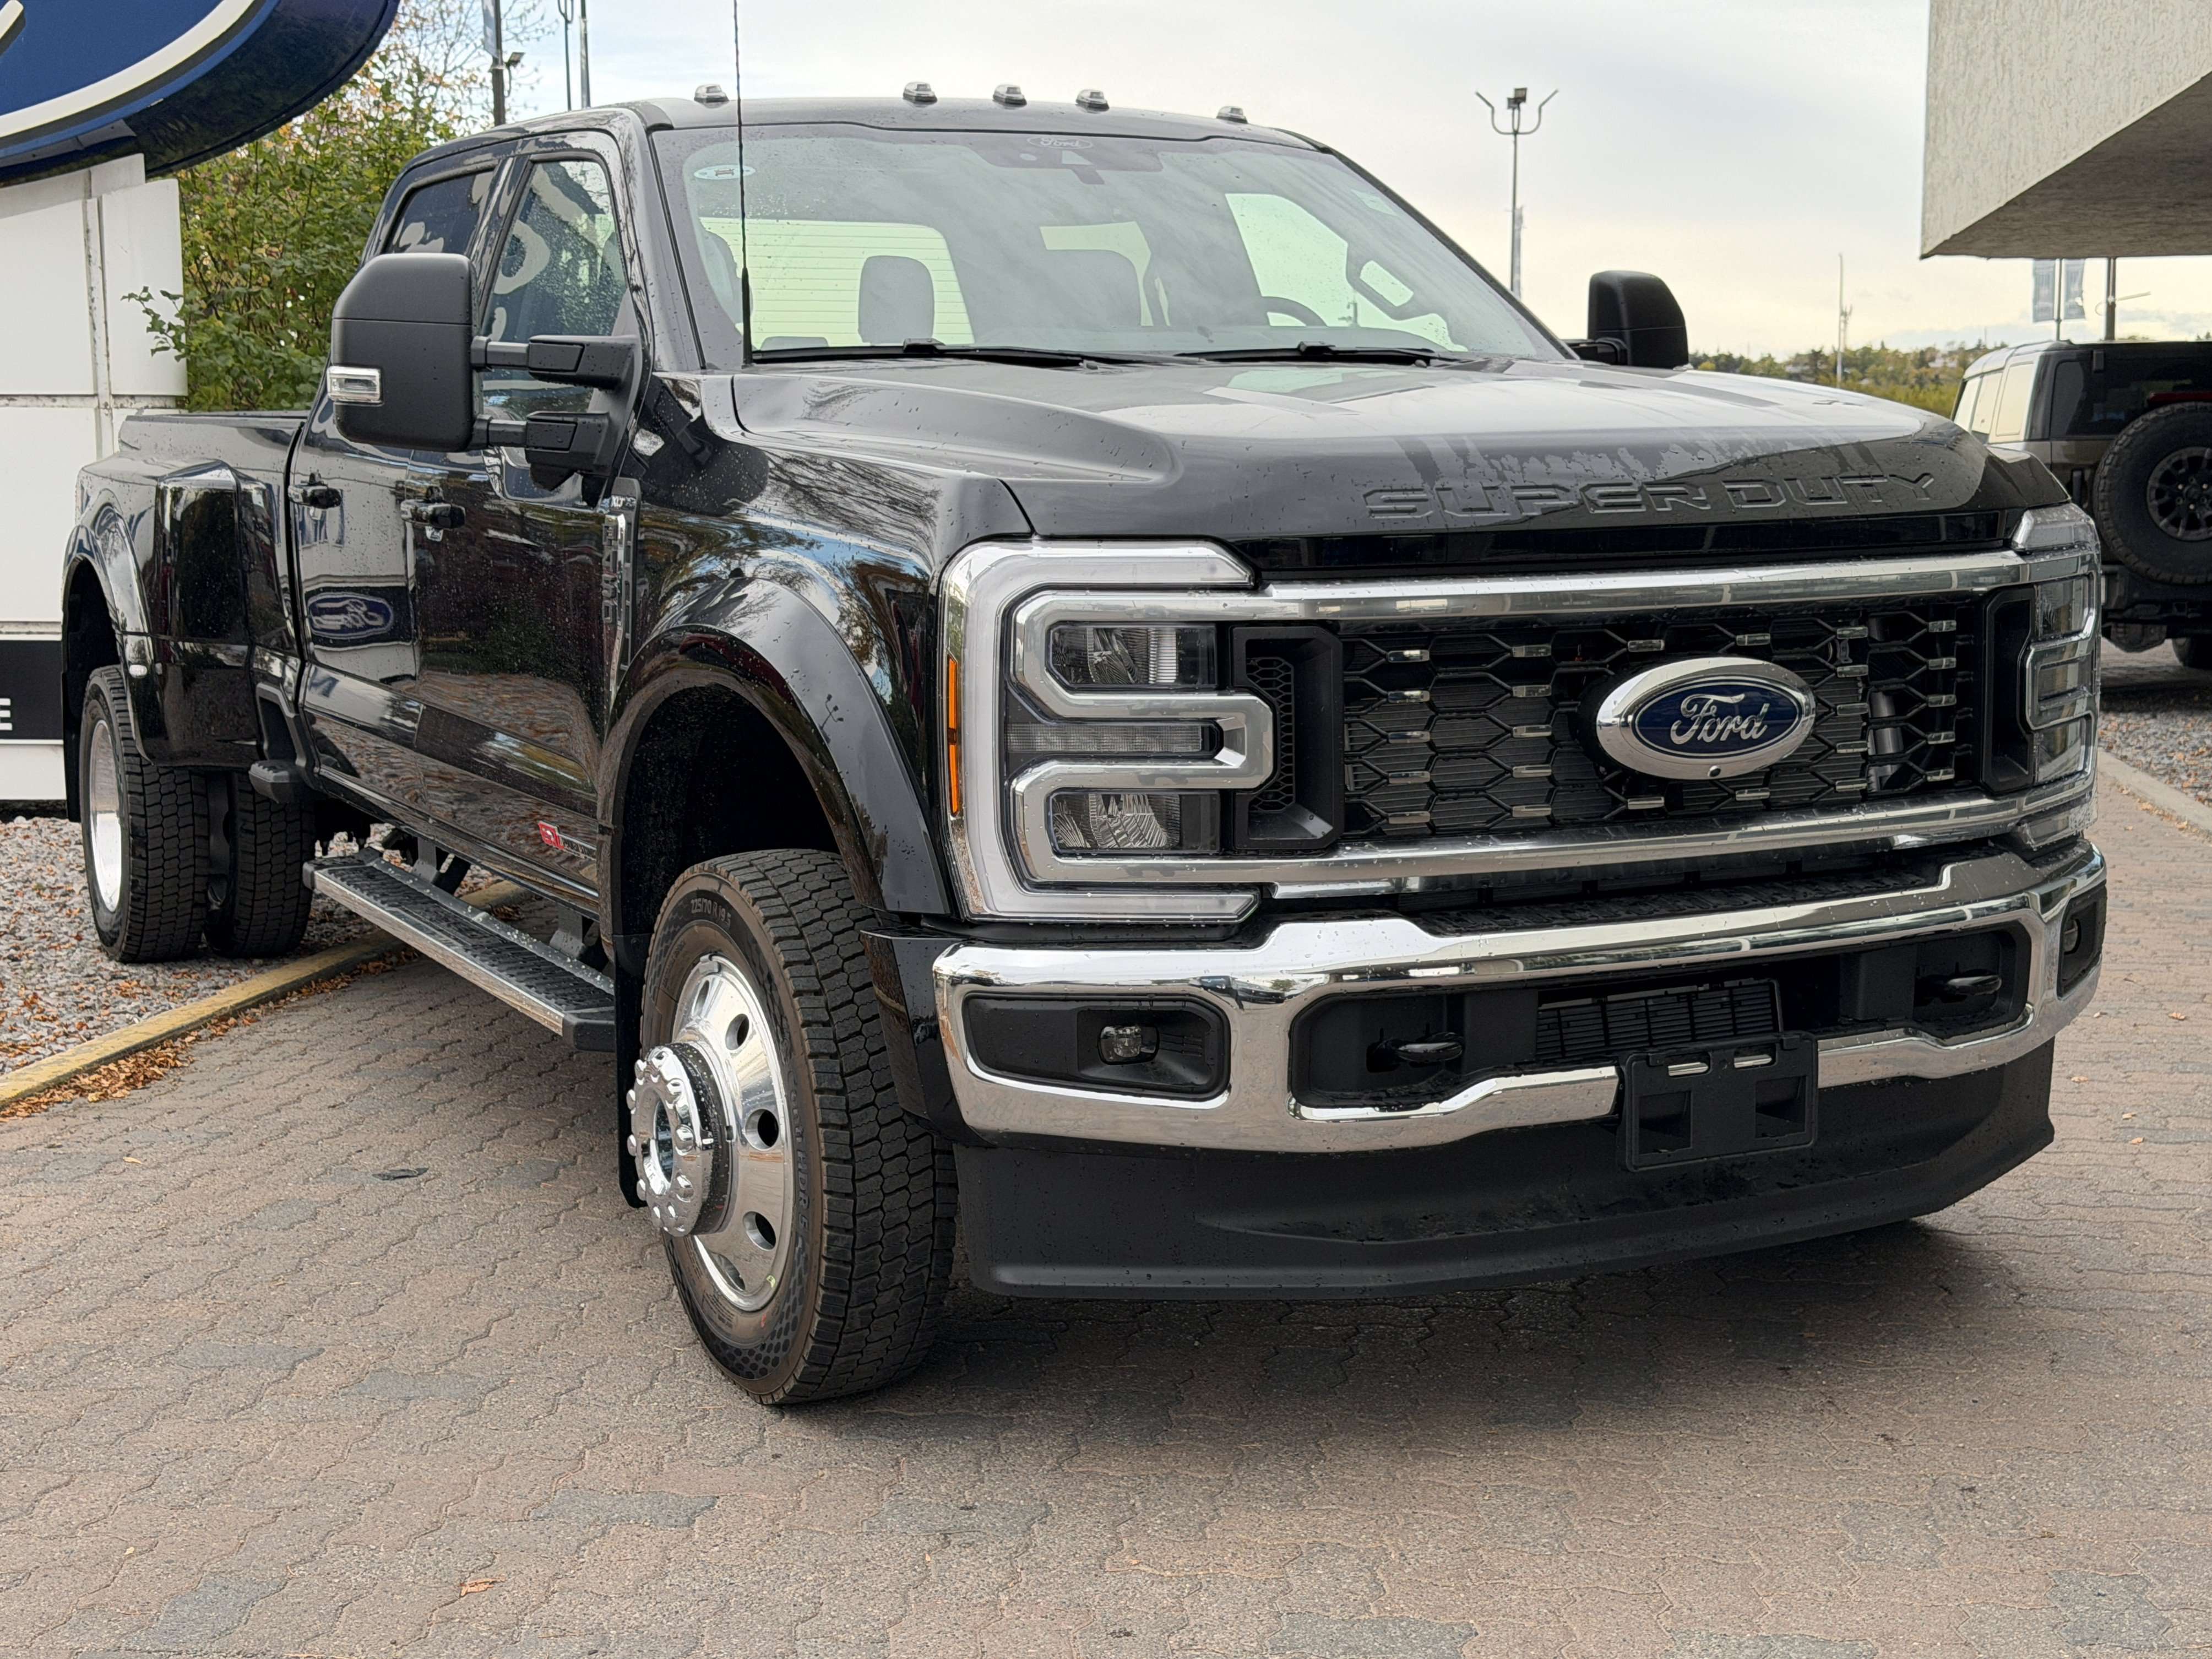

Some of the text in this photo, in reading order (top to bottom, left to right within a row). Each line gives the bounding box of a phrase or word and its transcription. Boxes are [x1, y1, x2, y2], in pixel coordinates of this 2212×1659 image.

[1040, 136, 1082, 147] Ford
[611, 495, 626, 508] XLT
[1362, 473, 1935, 519] SUPER DUTY
[1670, 693, 1770, 745] Ford
[691, 898, 712, 914] 225/70
[713, 902, 718, 918] R
[797, 1149, 809, 1210] HDR
